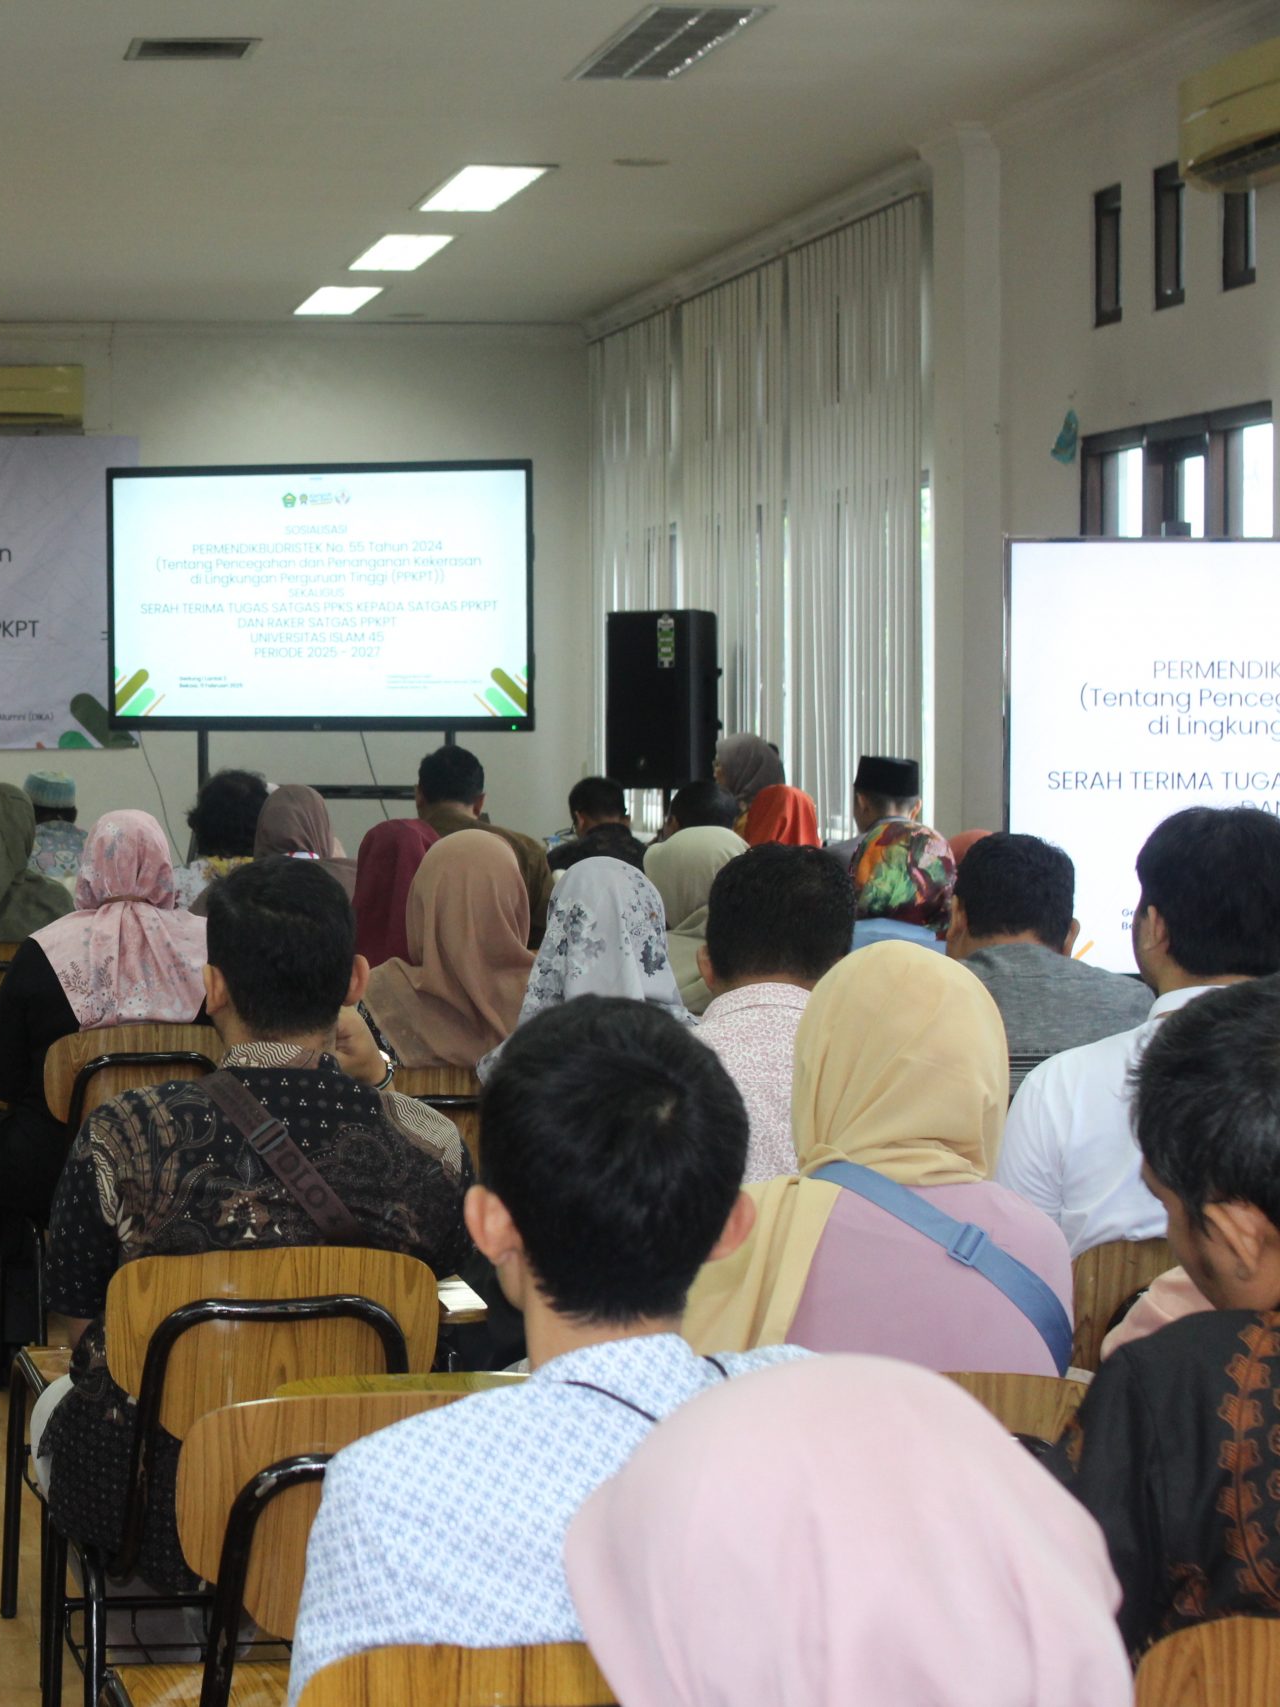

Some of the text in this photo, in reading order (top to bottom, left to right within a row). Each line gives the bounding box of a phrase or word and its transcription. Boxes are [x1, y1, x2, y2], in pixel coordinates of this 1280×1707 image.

[191, 542, 322, 555] PERMENDIKBUDRISTEK
[349, 542, 366, 553] 55
[369, 541, 409, 553] Tahun
[412, 540, 444, 552] 2024
[156, 555, 482, 573] (Tentang Pencegahan dan Penanganan Kekerasan
[190, 568, 446, 588] di Lingkungan Perguruan Tinggi (PPKPT))
[140, 600, 498, 614] SERAH TERIMA TUGAS SATGAS PPKS KEPADA SATGAS PPKPT
[237, 616, 397, 629] DAN RAKER SATGAS PPKPT
[250, 631, 385, 643] UNIVERSITAS ISLAM 45
[254, 646, 303, 659] PERIODE
[307, 646, 339, 658] 2025
[351, 645, 382, 657] 2027
[1153, 660, 1280, 680] PERMENDIK
[1080, 682, 1192, 714] (Tentang
[1148, 715, 1169, 736] di
[1047, 771, 1122, 791] SERAH
[1130, 771, 1214, 791] TERIMA
